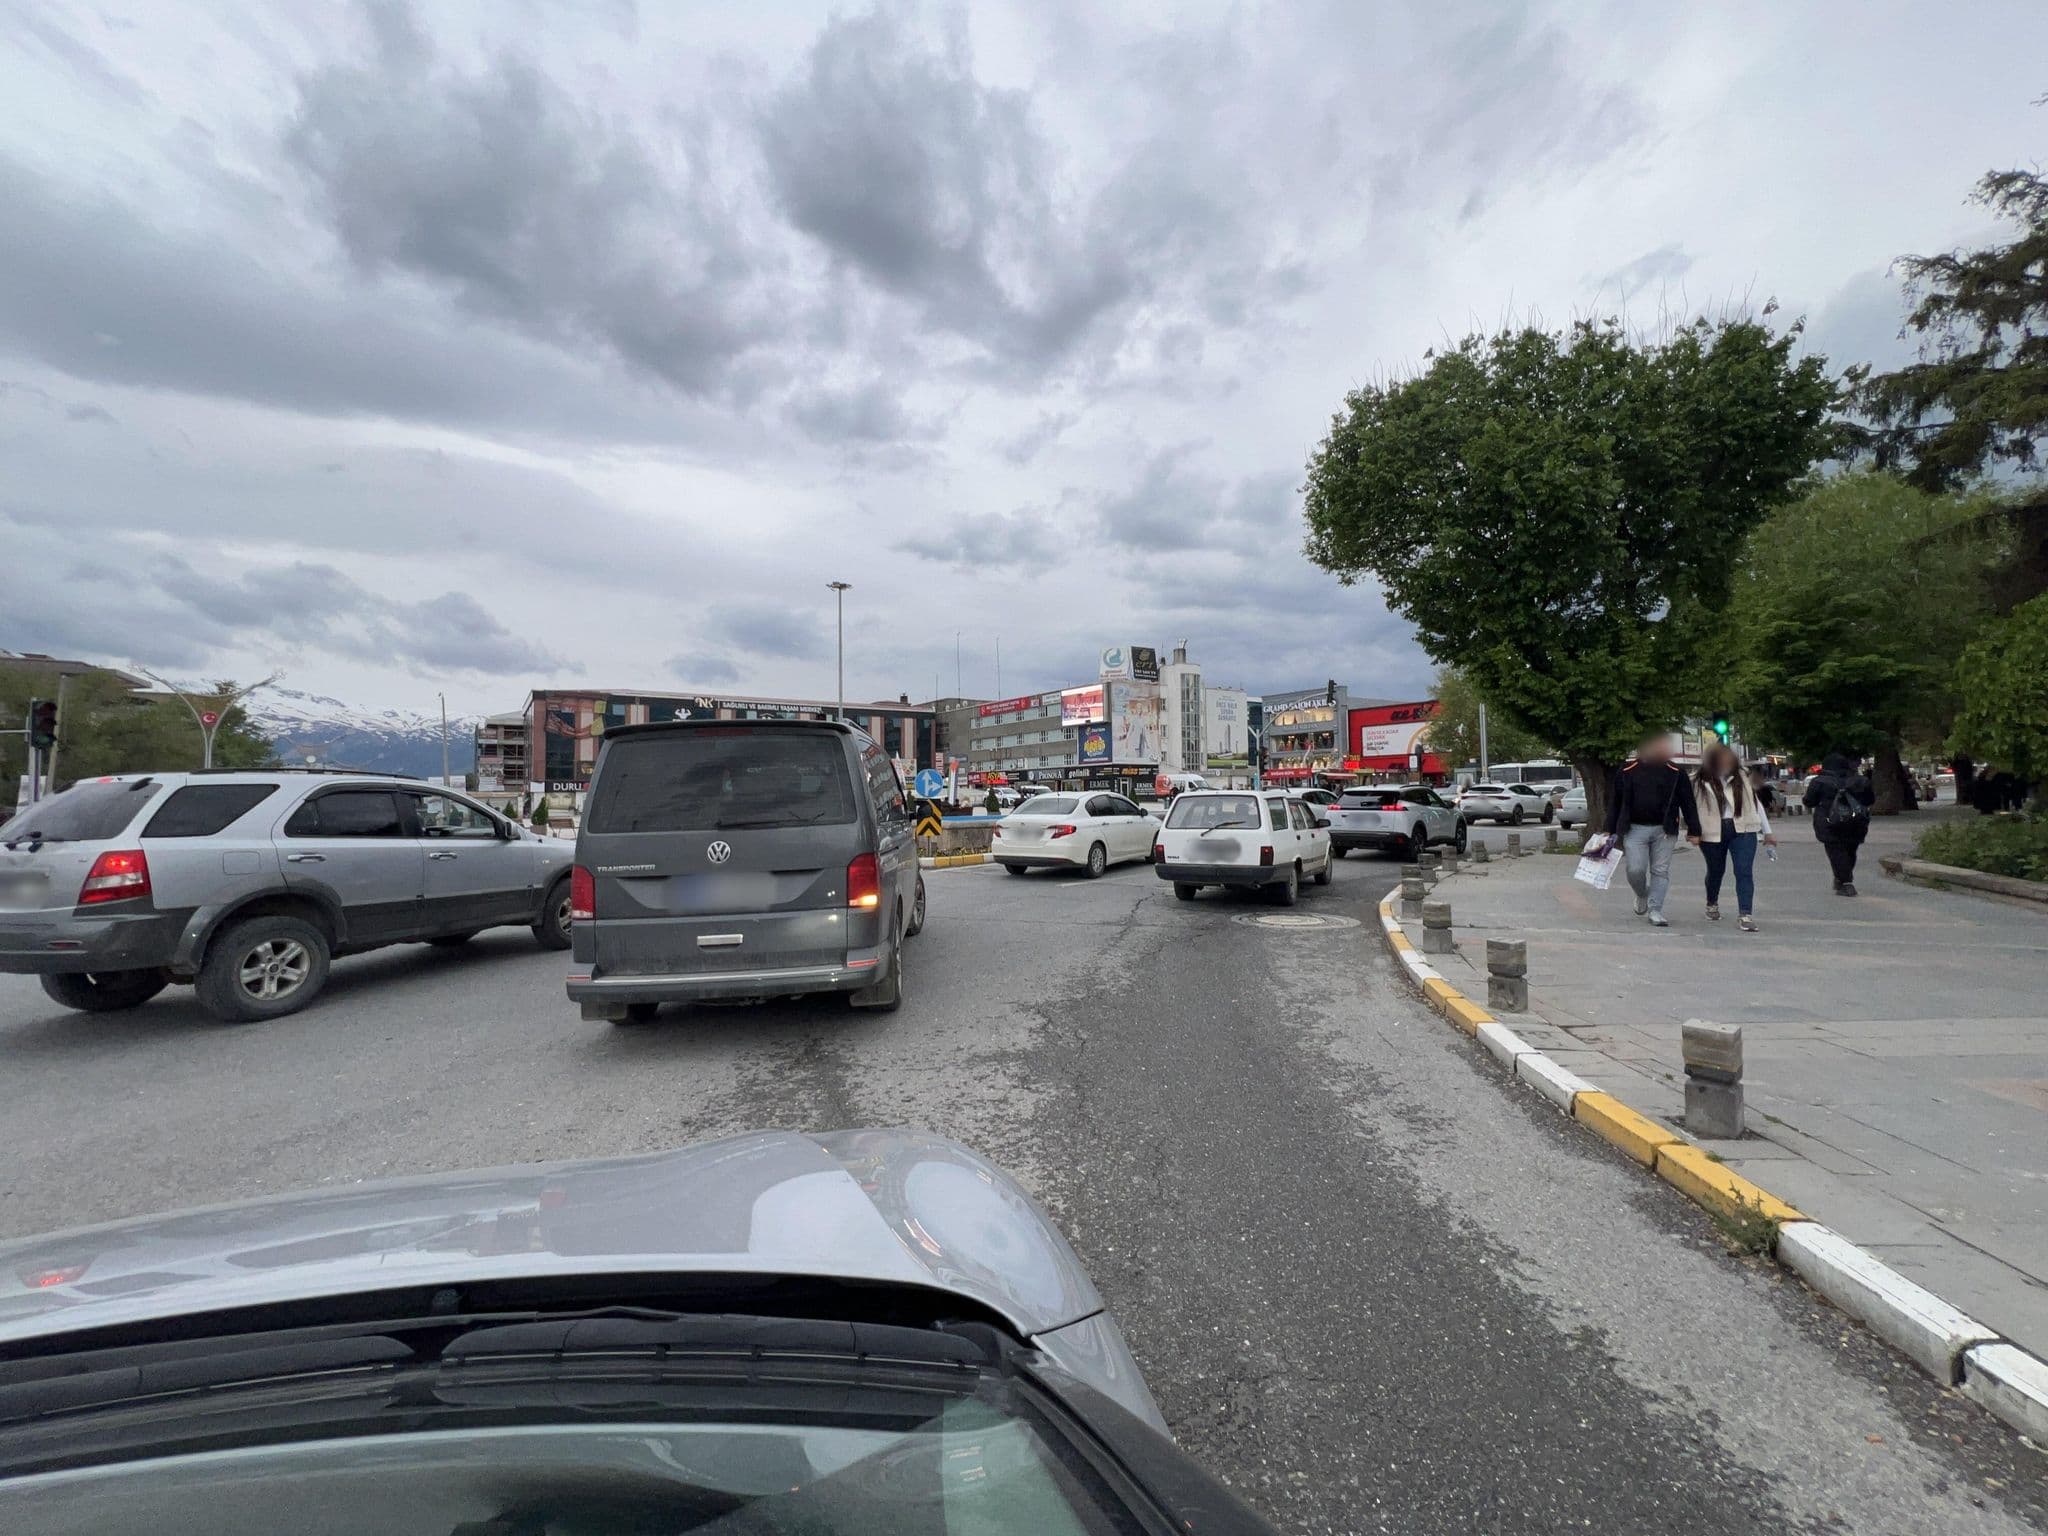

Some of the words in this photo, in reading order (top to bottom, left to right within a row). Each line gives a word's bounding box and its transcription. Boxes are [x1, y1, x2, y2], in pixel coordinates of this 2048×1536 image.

[1263, 704, 1288, 714] GRAND
[553, 782, 582, 791] DURU
[597, 864, 656, 872] TRANSPORTER
